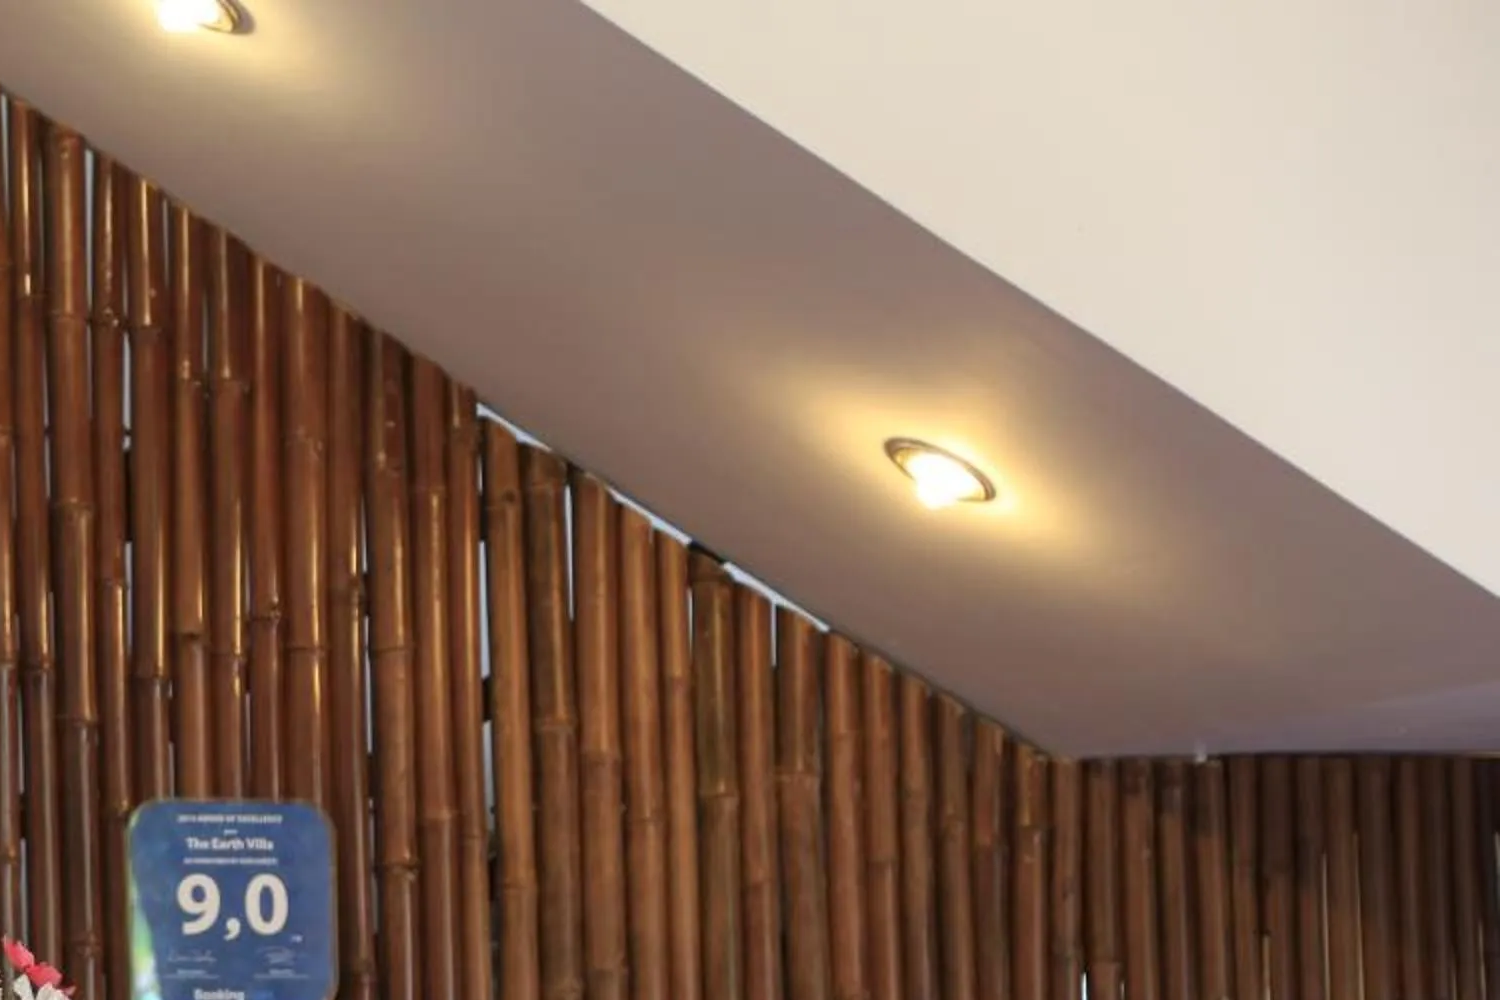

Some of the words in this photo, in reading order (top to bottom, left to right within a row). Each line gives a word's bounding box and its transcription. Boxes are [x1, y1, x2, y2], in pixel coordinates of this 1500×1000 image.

[185, 837, 209, 850] The
[211, 837, 244, 851] Earth
[245, 837, 275, 851] Villa
[176, 872, 289, 940] 9,0
